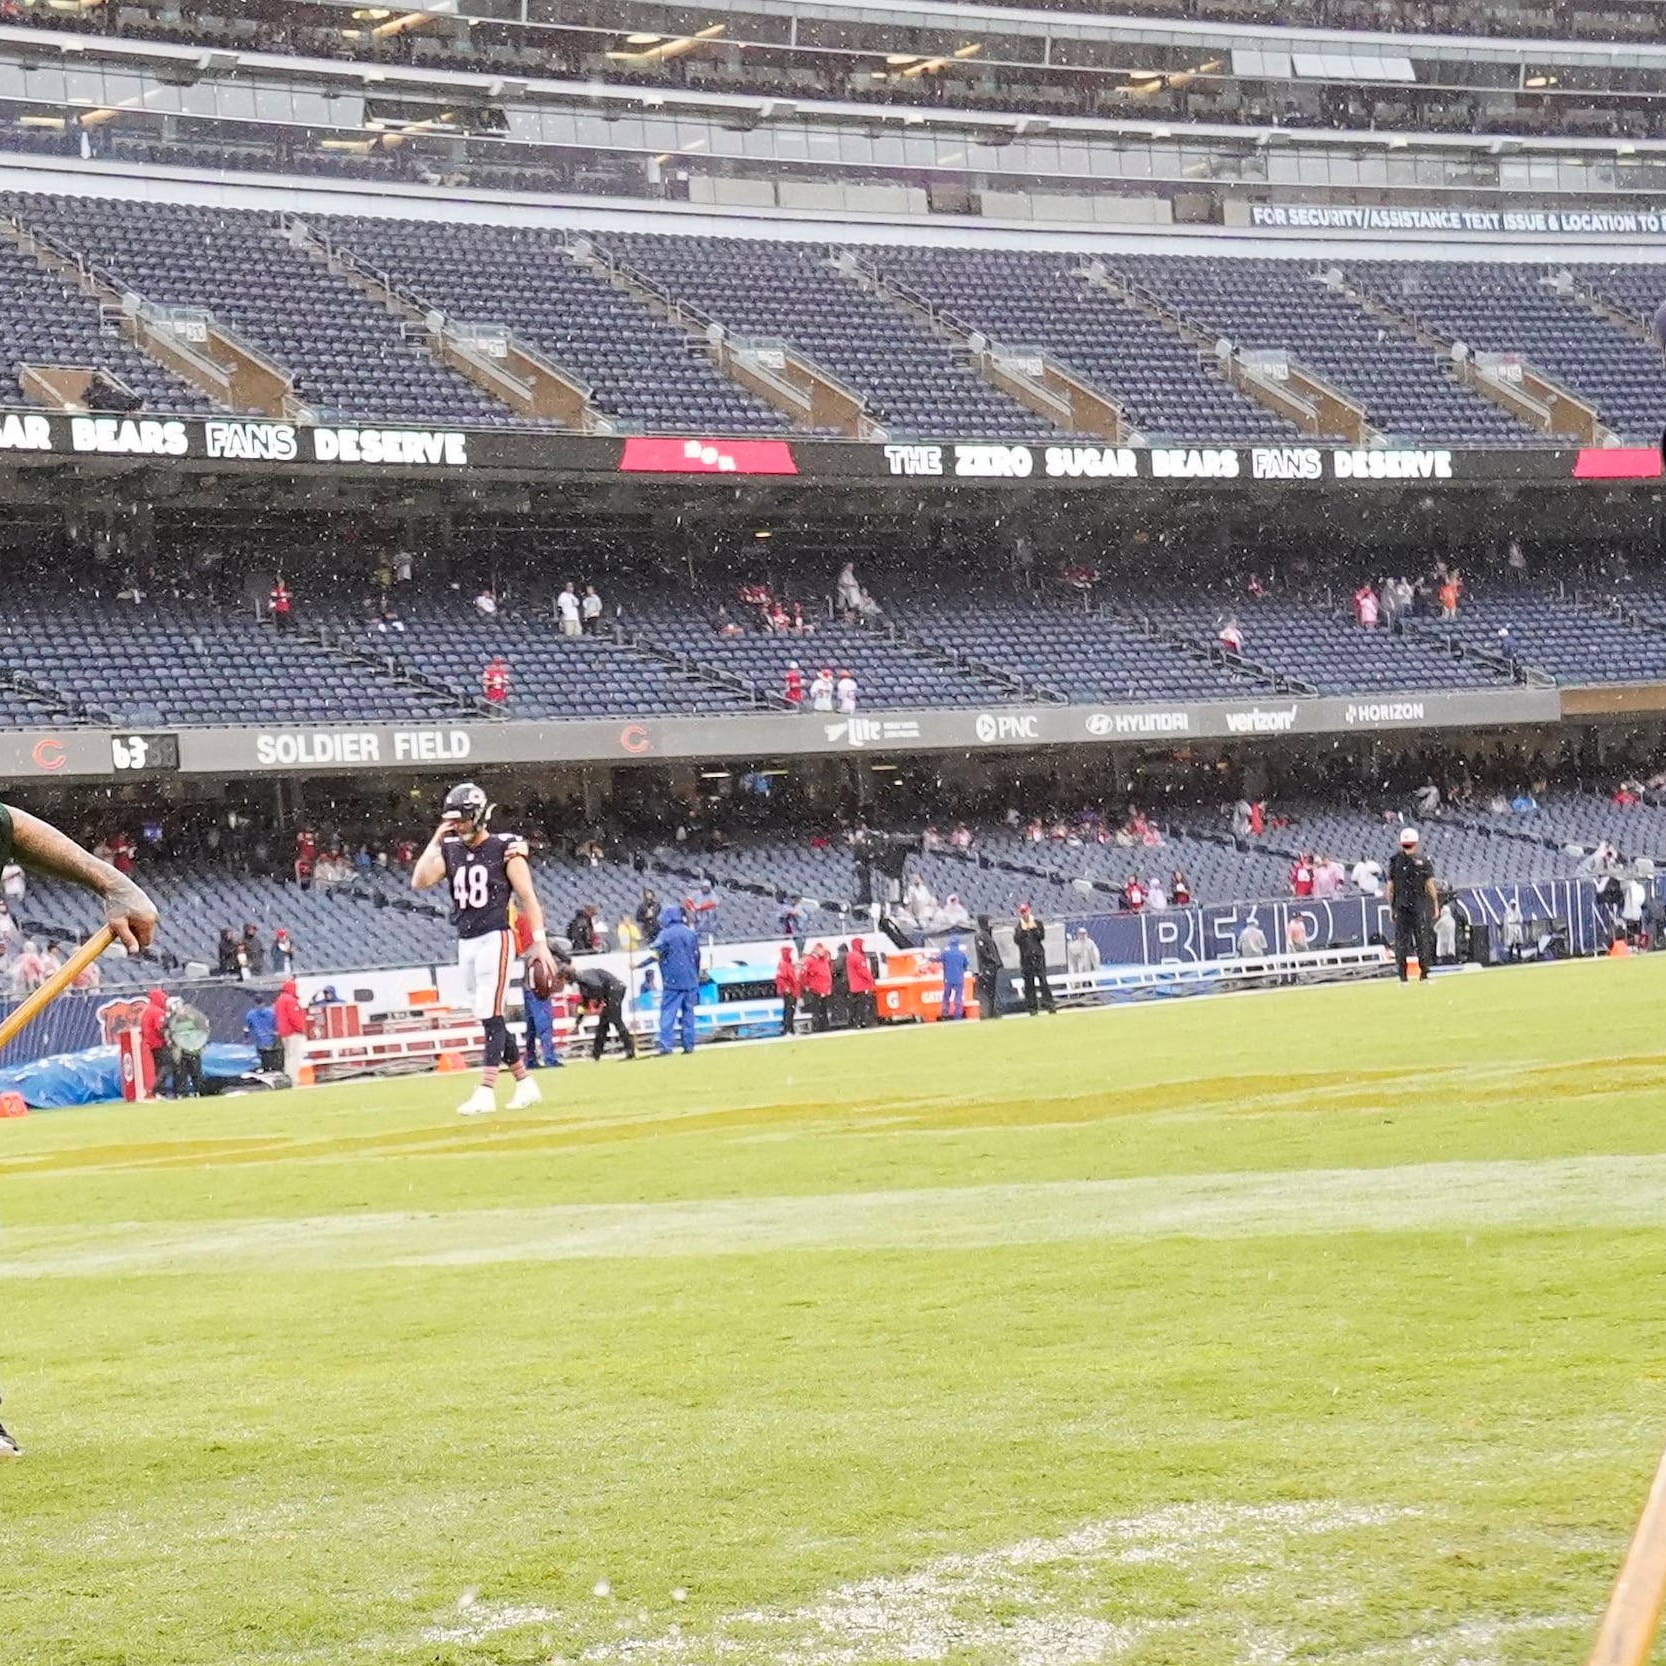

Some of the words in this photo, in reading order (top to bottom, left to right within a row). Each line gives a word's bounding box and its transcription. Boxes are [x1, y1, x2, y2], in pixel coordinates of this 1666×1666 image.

[1253, 208, 1287, 224] FOR
[1290, 208, 1462, 229] SECURITY/ASSISTANCE
[1463, 213, 1500, 229] TEXT
[1504, 214, 1546, 231] ISSUE
[1561, 214, 1637, 231] LOCATION
[1639, 215, 1659, 231] TO
[71, 418, 188, 455] BEARS
[204, 421, 298, 460] FANS
[313, 429, 467, 465] DESERVE
[884, 446, 943, 475] THE
[955, 446, 1033, 478] ZERO
[1045, 447, 1138, 477] SUGAR
[1151, 449, 1240, 478] BEARS
[1252, 448, 1323, 479] FANS
[1334, 450, 1453, 479] DESERVE
[1116, 713, 1189, 731] HYUNDAI
[1225, 706, 1294, 732] verizon
[1359, 703, 1424, 721] HORIZON
[999, 717, 1039, 738] PNC
[257, 733, 379, 765] SOLDIER
[395, 731, 471, 760] FIELD
[453, 864, 488, 909] 48
